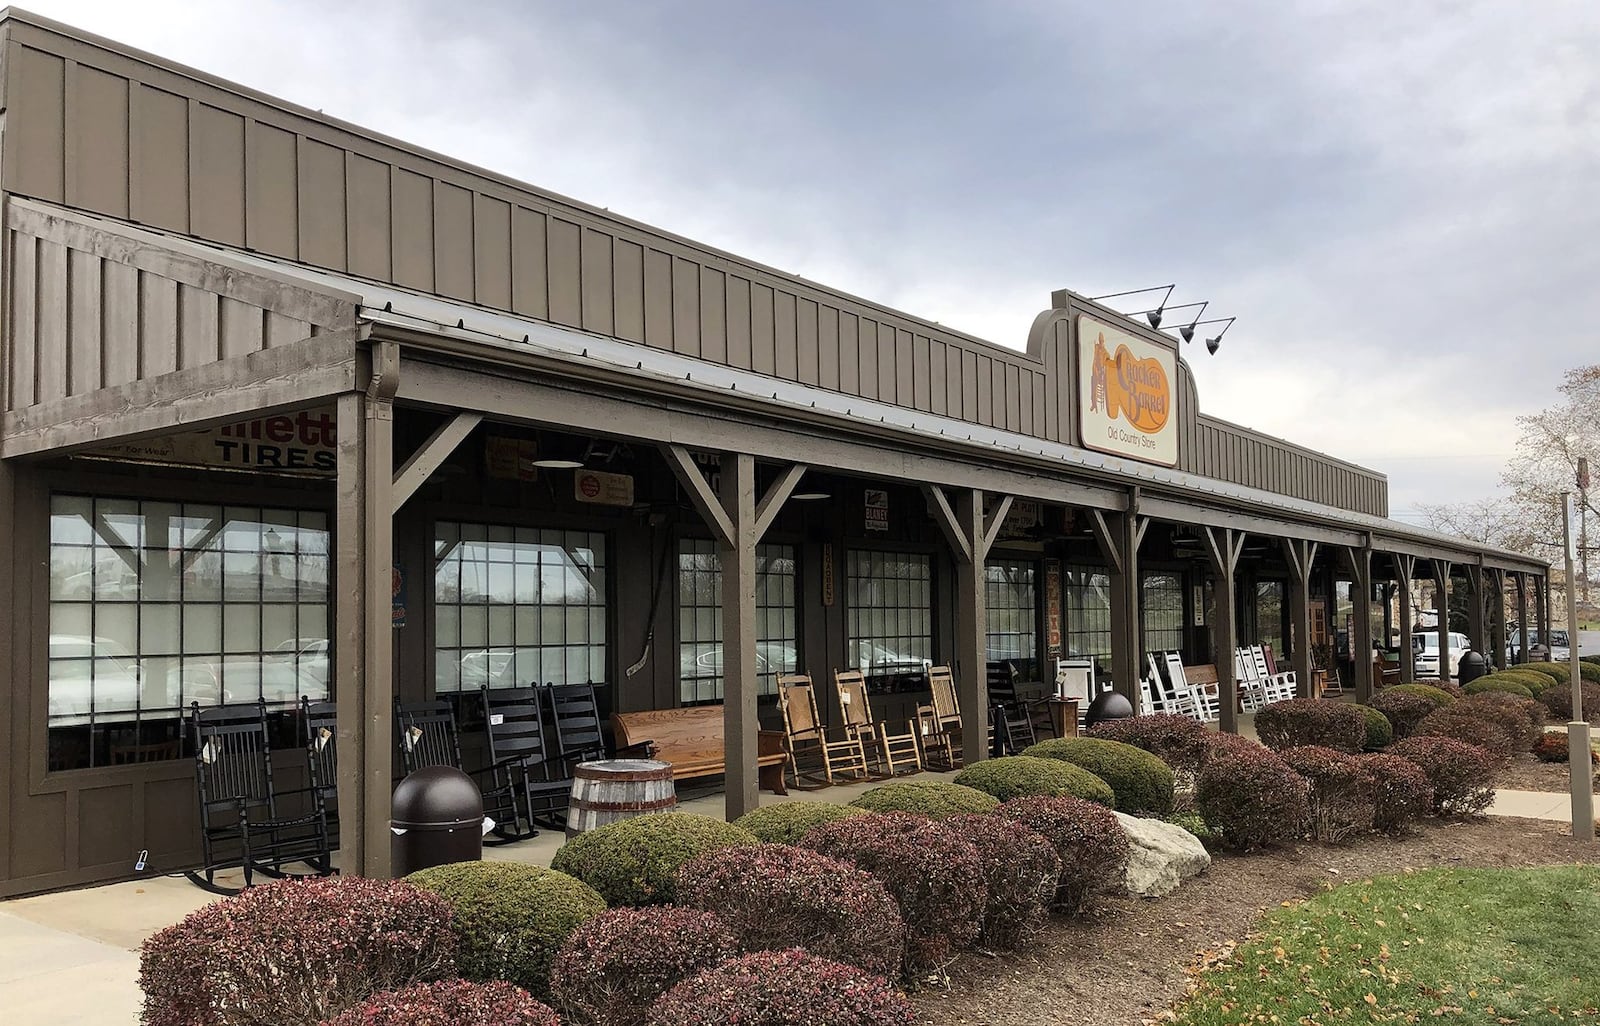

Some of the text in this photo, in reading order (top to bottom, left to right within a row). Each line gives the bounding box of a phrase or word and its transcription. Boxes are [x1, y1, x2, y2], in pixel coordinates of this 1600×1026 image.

[1117, 348, 1160, 391] Cracker
[1128, 381, 1165, 422] Barrel
[214, 439, 336, 471] TIRES
[1107, 426, 1156, 449] Old Country Store
